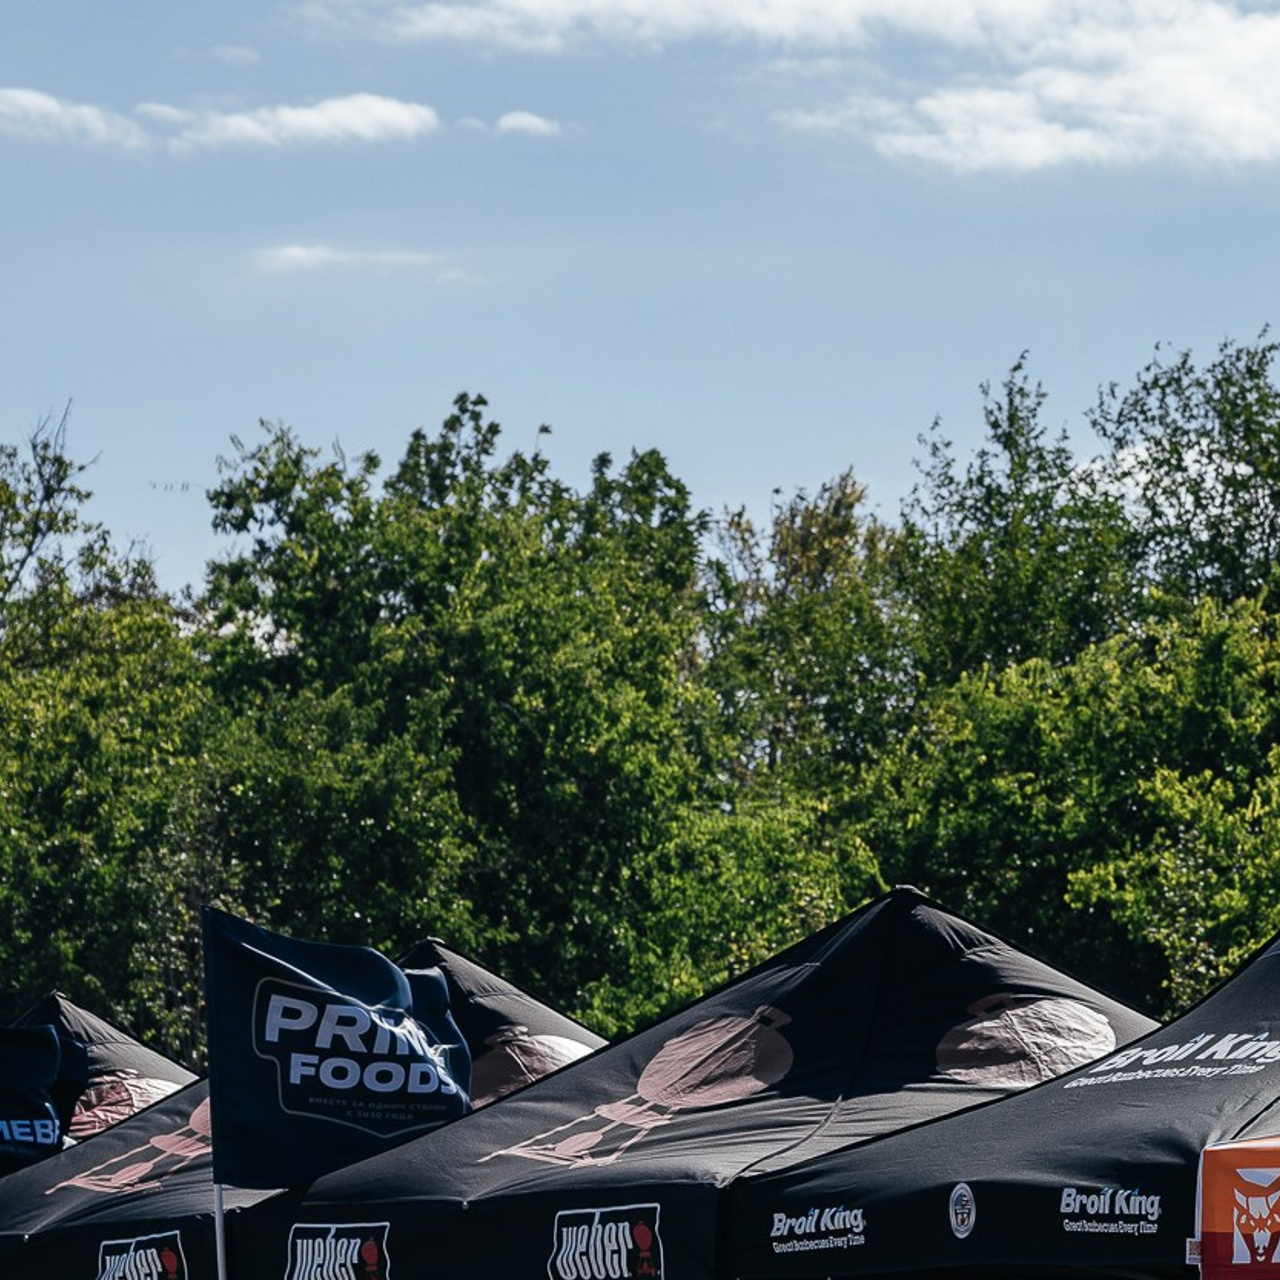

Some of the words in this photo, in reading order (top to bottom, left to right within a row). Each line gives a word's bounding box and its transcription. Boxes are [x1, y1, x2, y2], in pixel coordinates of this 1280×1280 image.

[1090, 1032, 1215, 1073] Broil
[770, 1208, 820, 1237] Broil
[820, 1205, 864, 1232] King
[1060, 1187, 1113, 1214] Broil
[1114, 1188, 1161, 1221] King
[557, 1213, 633, 1280] weber
